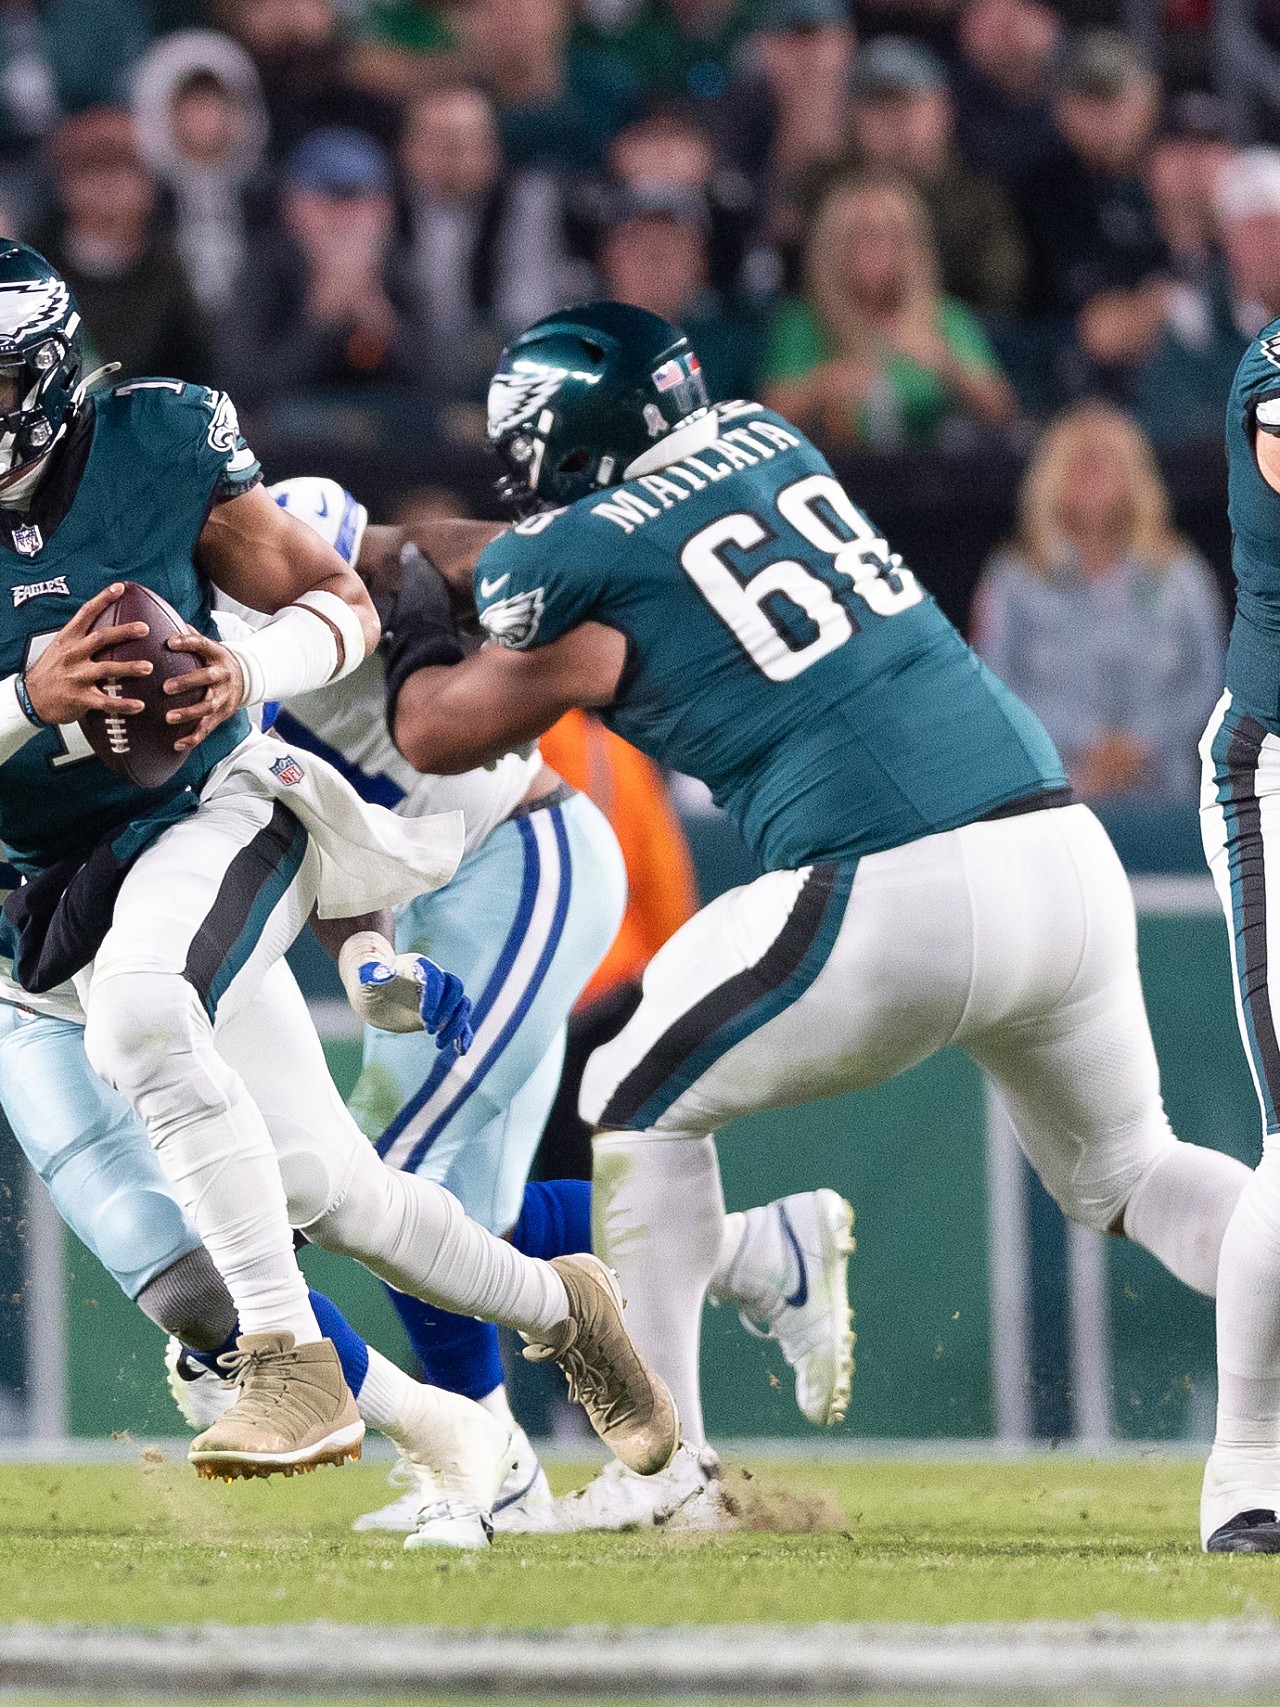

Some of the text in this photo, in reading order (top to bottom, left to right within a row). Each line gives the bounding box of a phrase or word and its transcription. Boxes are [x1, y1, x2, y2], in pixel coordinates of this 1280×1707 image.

[590, 421, 800, 535] MAILATA
[10, 575, 70, 607] EAGLES
[680, 474, 922, 682] 68
